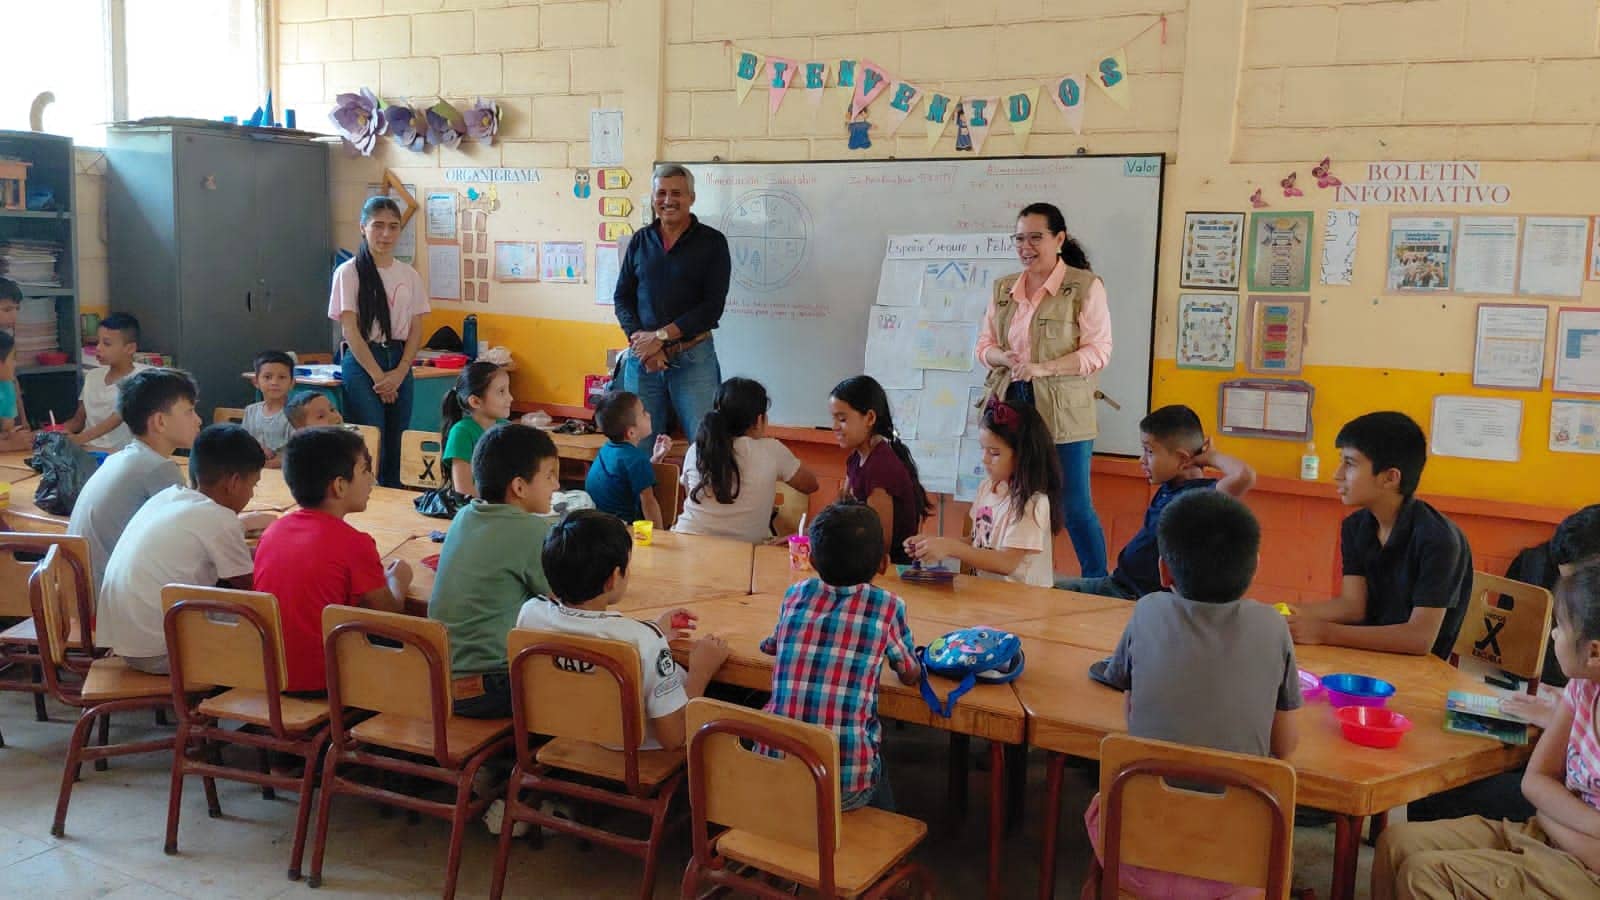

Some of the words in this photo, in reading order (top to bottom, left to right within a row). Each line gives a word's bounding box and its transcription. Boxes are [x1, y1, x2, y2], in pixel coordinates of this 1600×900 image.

[737, 51, 1125, 127] BIENVENIDOS
[446, 168, 543, 183] ORGANIGRAMA
[1126, 159, 1159, 174] Valor
[1367, 163, 1479, 181] BOLETIN
[1334, 184, 1511, 203] INFORMATIVO
